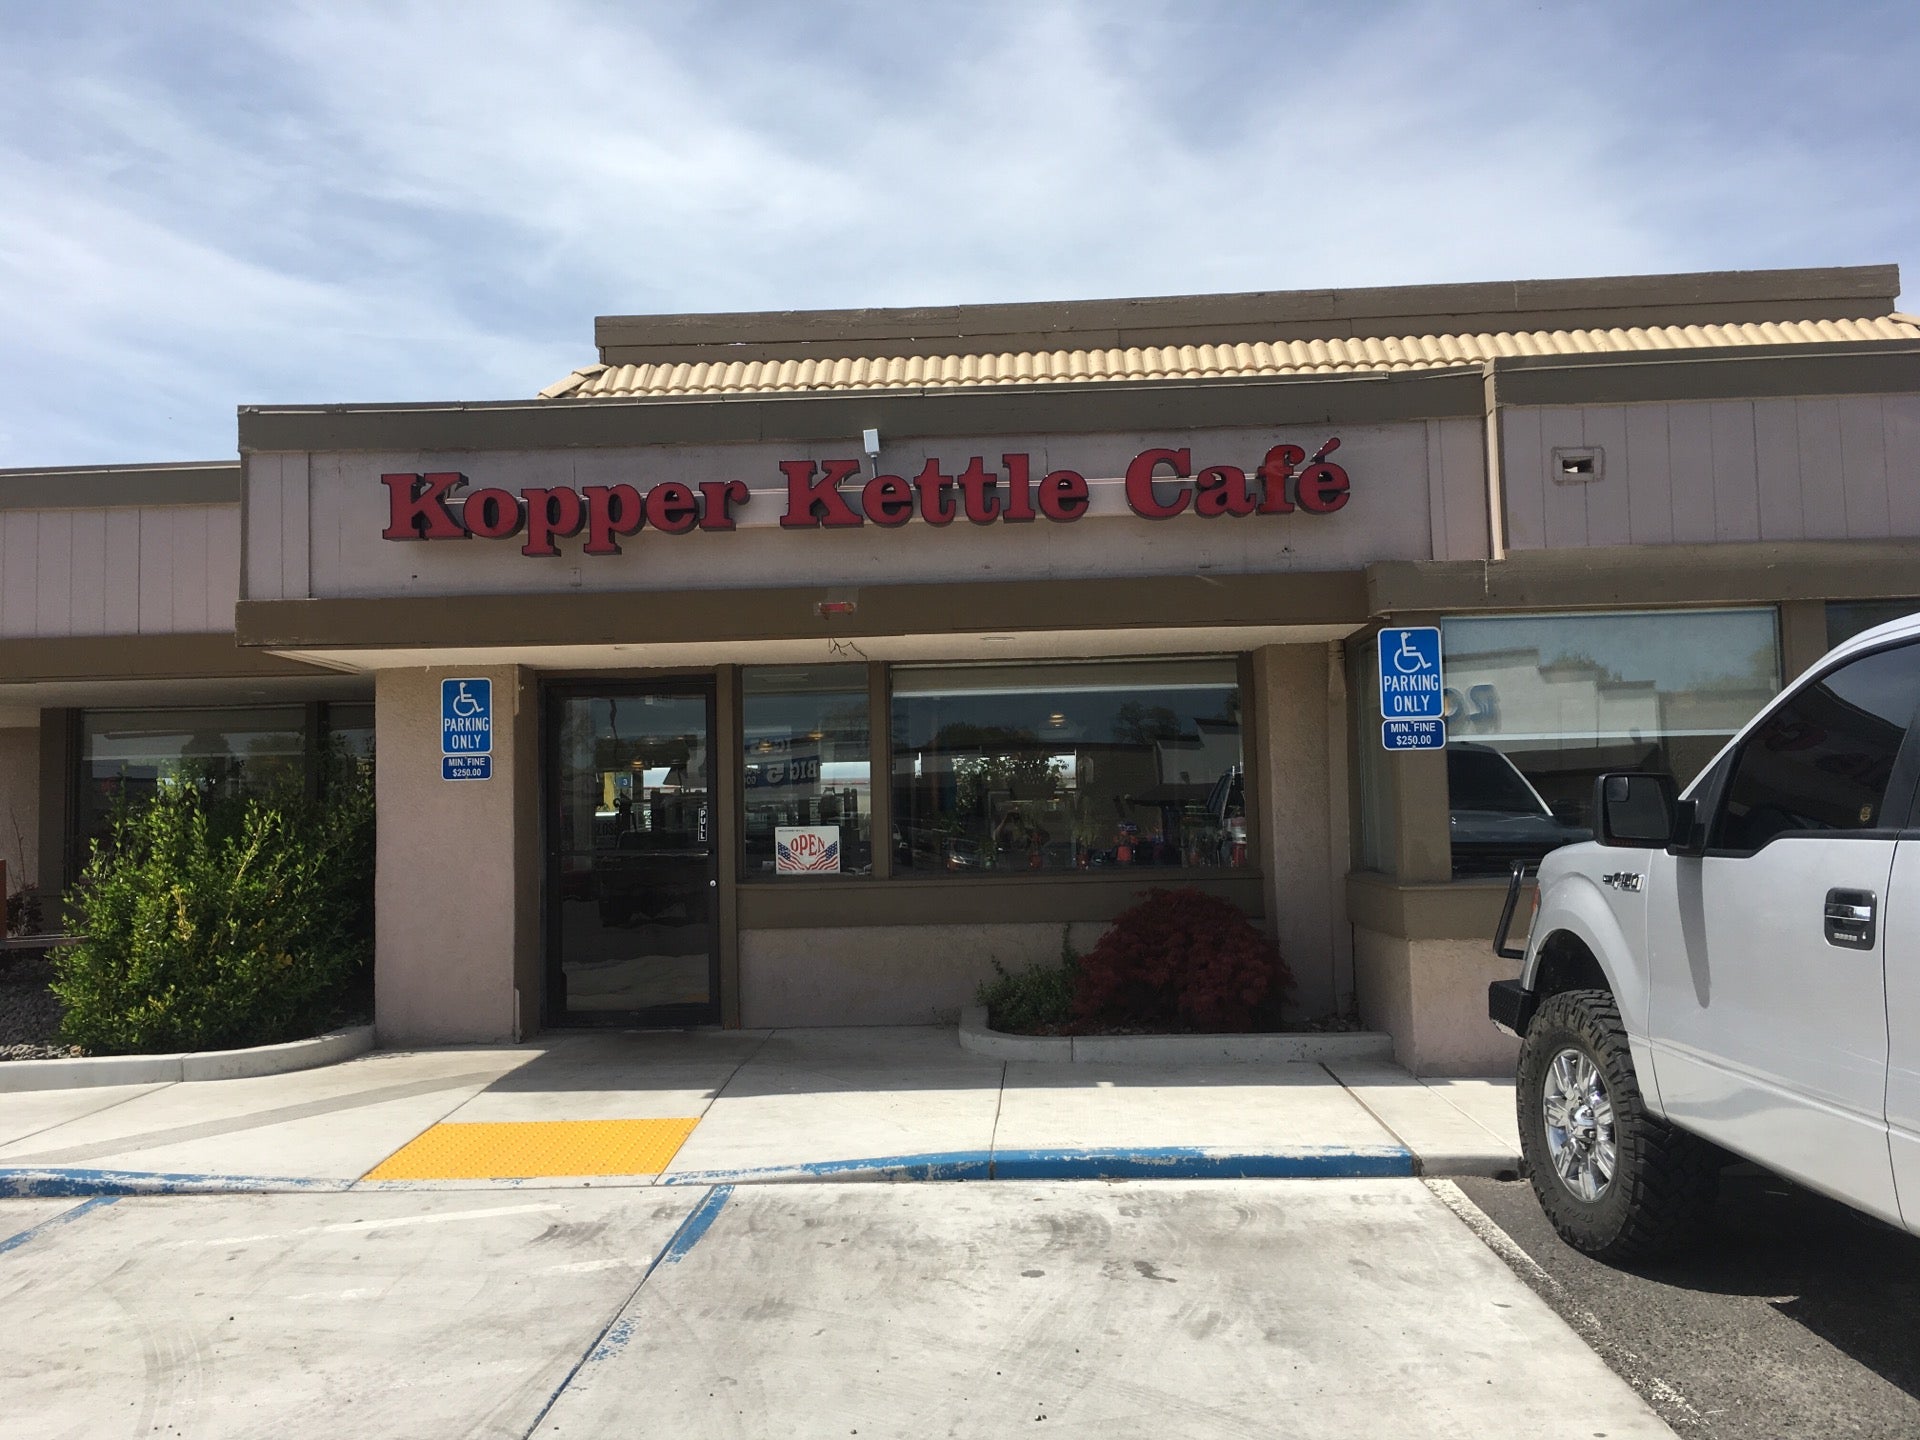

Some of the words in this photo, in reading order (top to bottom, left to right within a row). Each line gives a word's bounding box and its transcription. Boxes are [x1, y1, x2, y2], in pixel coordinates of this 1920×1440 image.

[381, 472, 749, 557] Kopper
[779, 453, 1090, 528] Kettle
[1125, 437, 1350, 519] Café
[1383, 674, 1439, 692] PARKING
[1393, 695, 1430, 712] ONLY
[444, 717, 489, 732] PARKING
[1390, 723, 1411, 733] MIN.
[1413, 722, 1436, 732] FINE
[452, 734, 481, 749] ONLY
[1396, 734, 1432, 746] $250.00
[448, 758, 465, 767] MIN.
[467, 757, 485, 766] FINE
[452, 768, 482, 777] $250.00
[790, 834, 825, 856] OPEN
